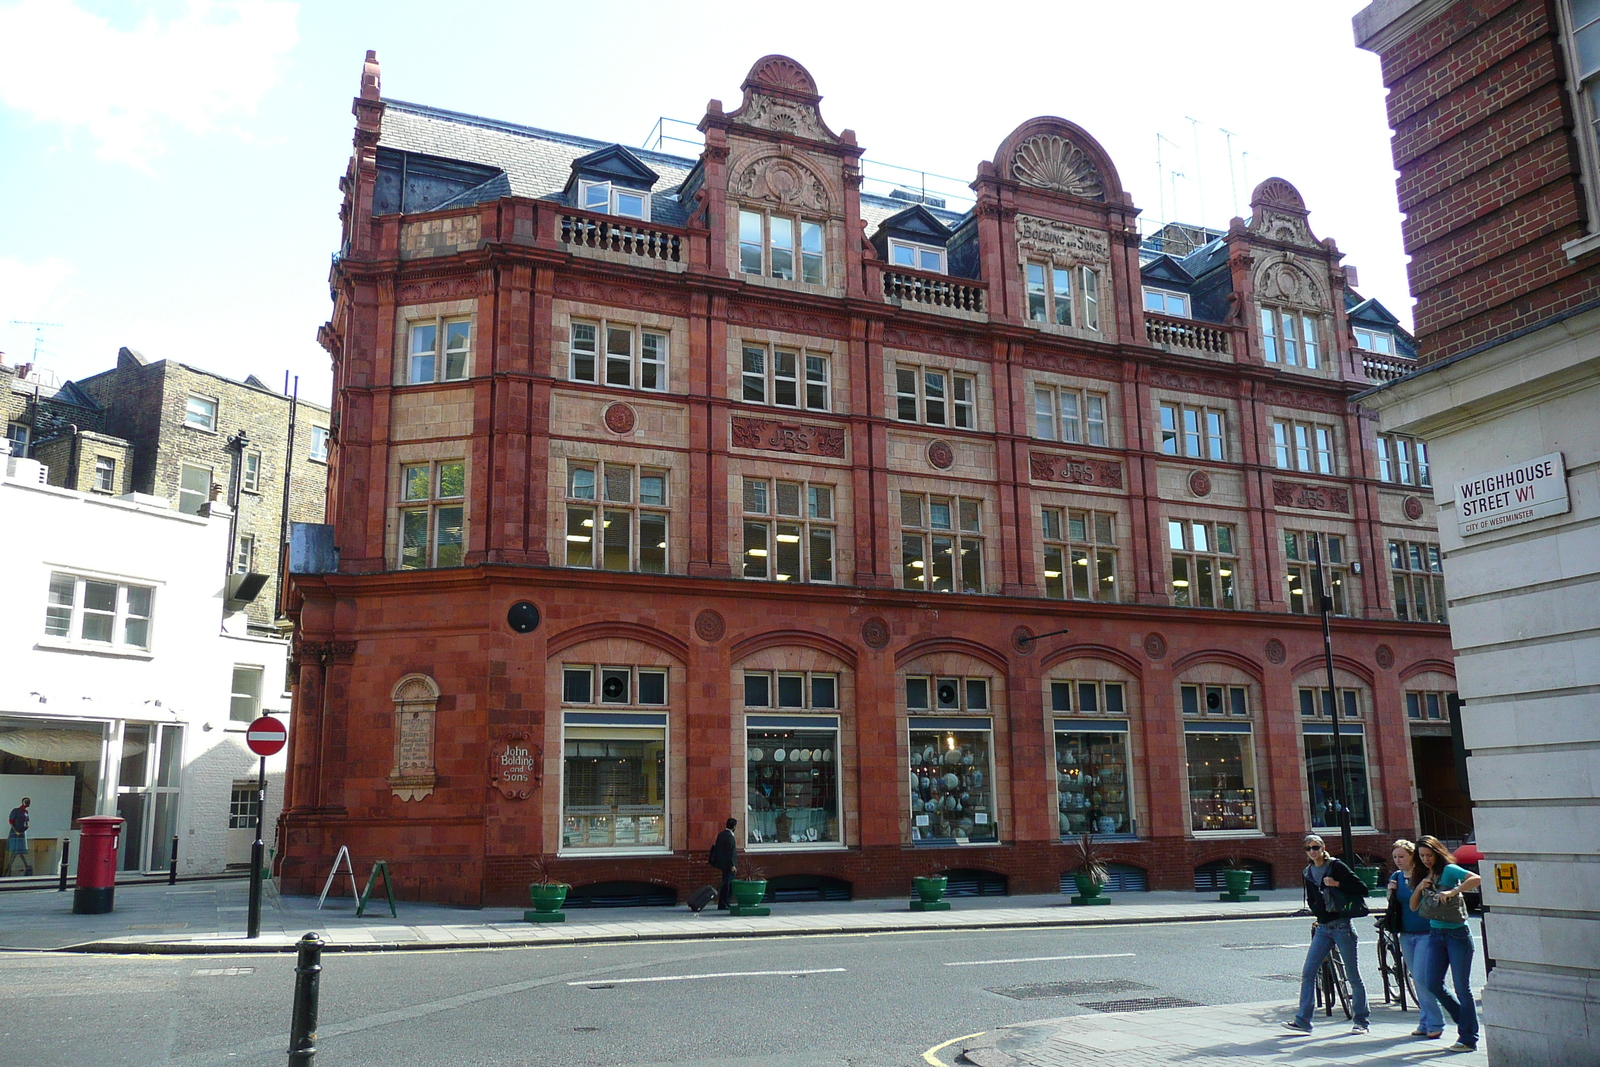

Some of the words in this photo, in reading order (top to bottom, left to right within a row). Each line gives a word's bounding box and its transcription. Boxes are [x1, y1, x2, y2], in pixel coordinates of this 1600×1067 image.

[1461, 461, 1552, 498] WEIGHHOUSE
[1463, 491, 1510, 516] STREET
[1515, 485, 1535, 503] W1
[1465, 523, 1479, 532] CITY
[1480, 520, 1488, 528] OF
[1489, 509, 1534, 526] WESTMINSTER
[503, 745, 528, 756] John
[500, 755, 534, 771] Bolding
[509, 765, 524, 773] and
[502, 770, 529, 782] Sons
